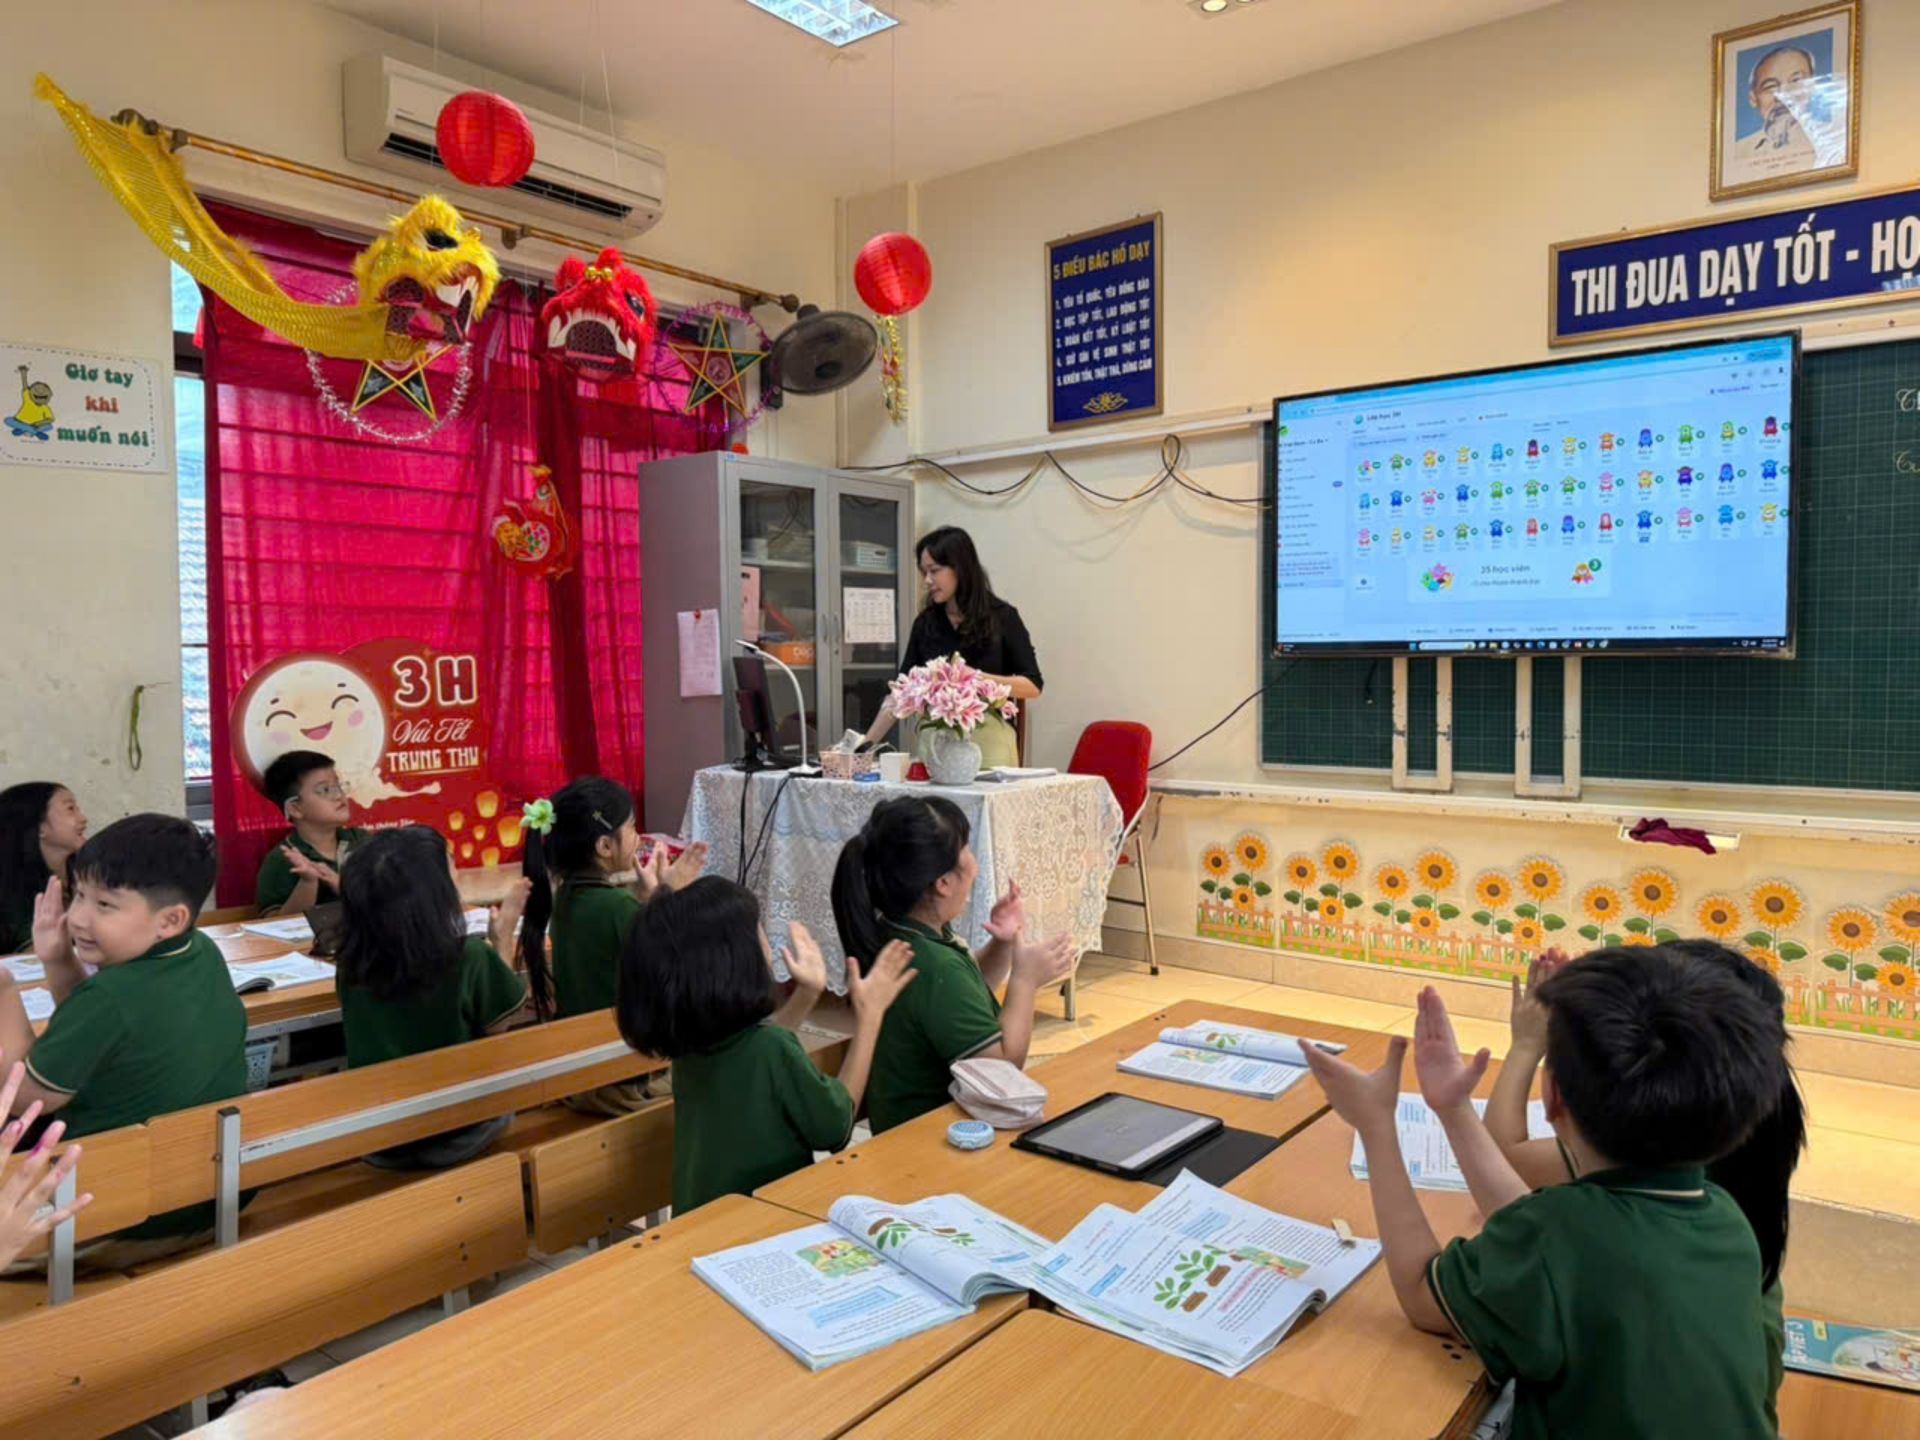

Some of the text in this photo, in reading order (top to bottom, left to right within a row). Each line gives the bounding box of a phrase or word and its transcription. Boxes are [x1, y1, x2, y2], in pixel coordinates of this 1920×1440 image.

[1054, 264, 1060, 280] 5
[1088, 249, 1110, 272] BÁC
[1571, 265, 1617, 316] THI
[1626, 254, 1688, 309] ĐUA
[1699, 242, 1764, 306] DẠY
[1773, 213, 1836, 287] TỐT
[66, 363, 134, 388] Giơ tay
[86, 396, 119, 413] khi
[58, 426, 148, 447] muốn nói
[392, 718, 474, 746] Vui Tết
[386, 747, 479, 773] TRUNG THU
